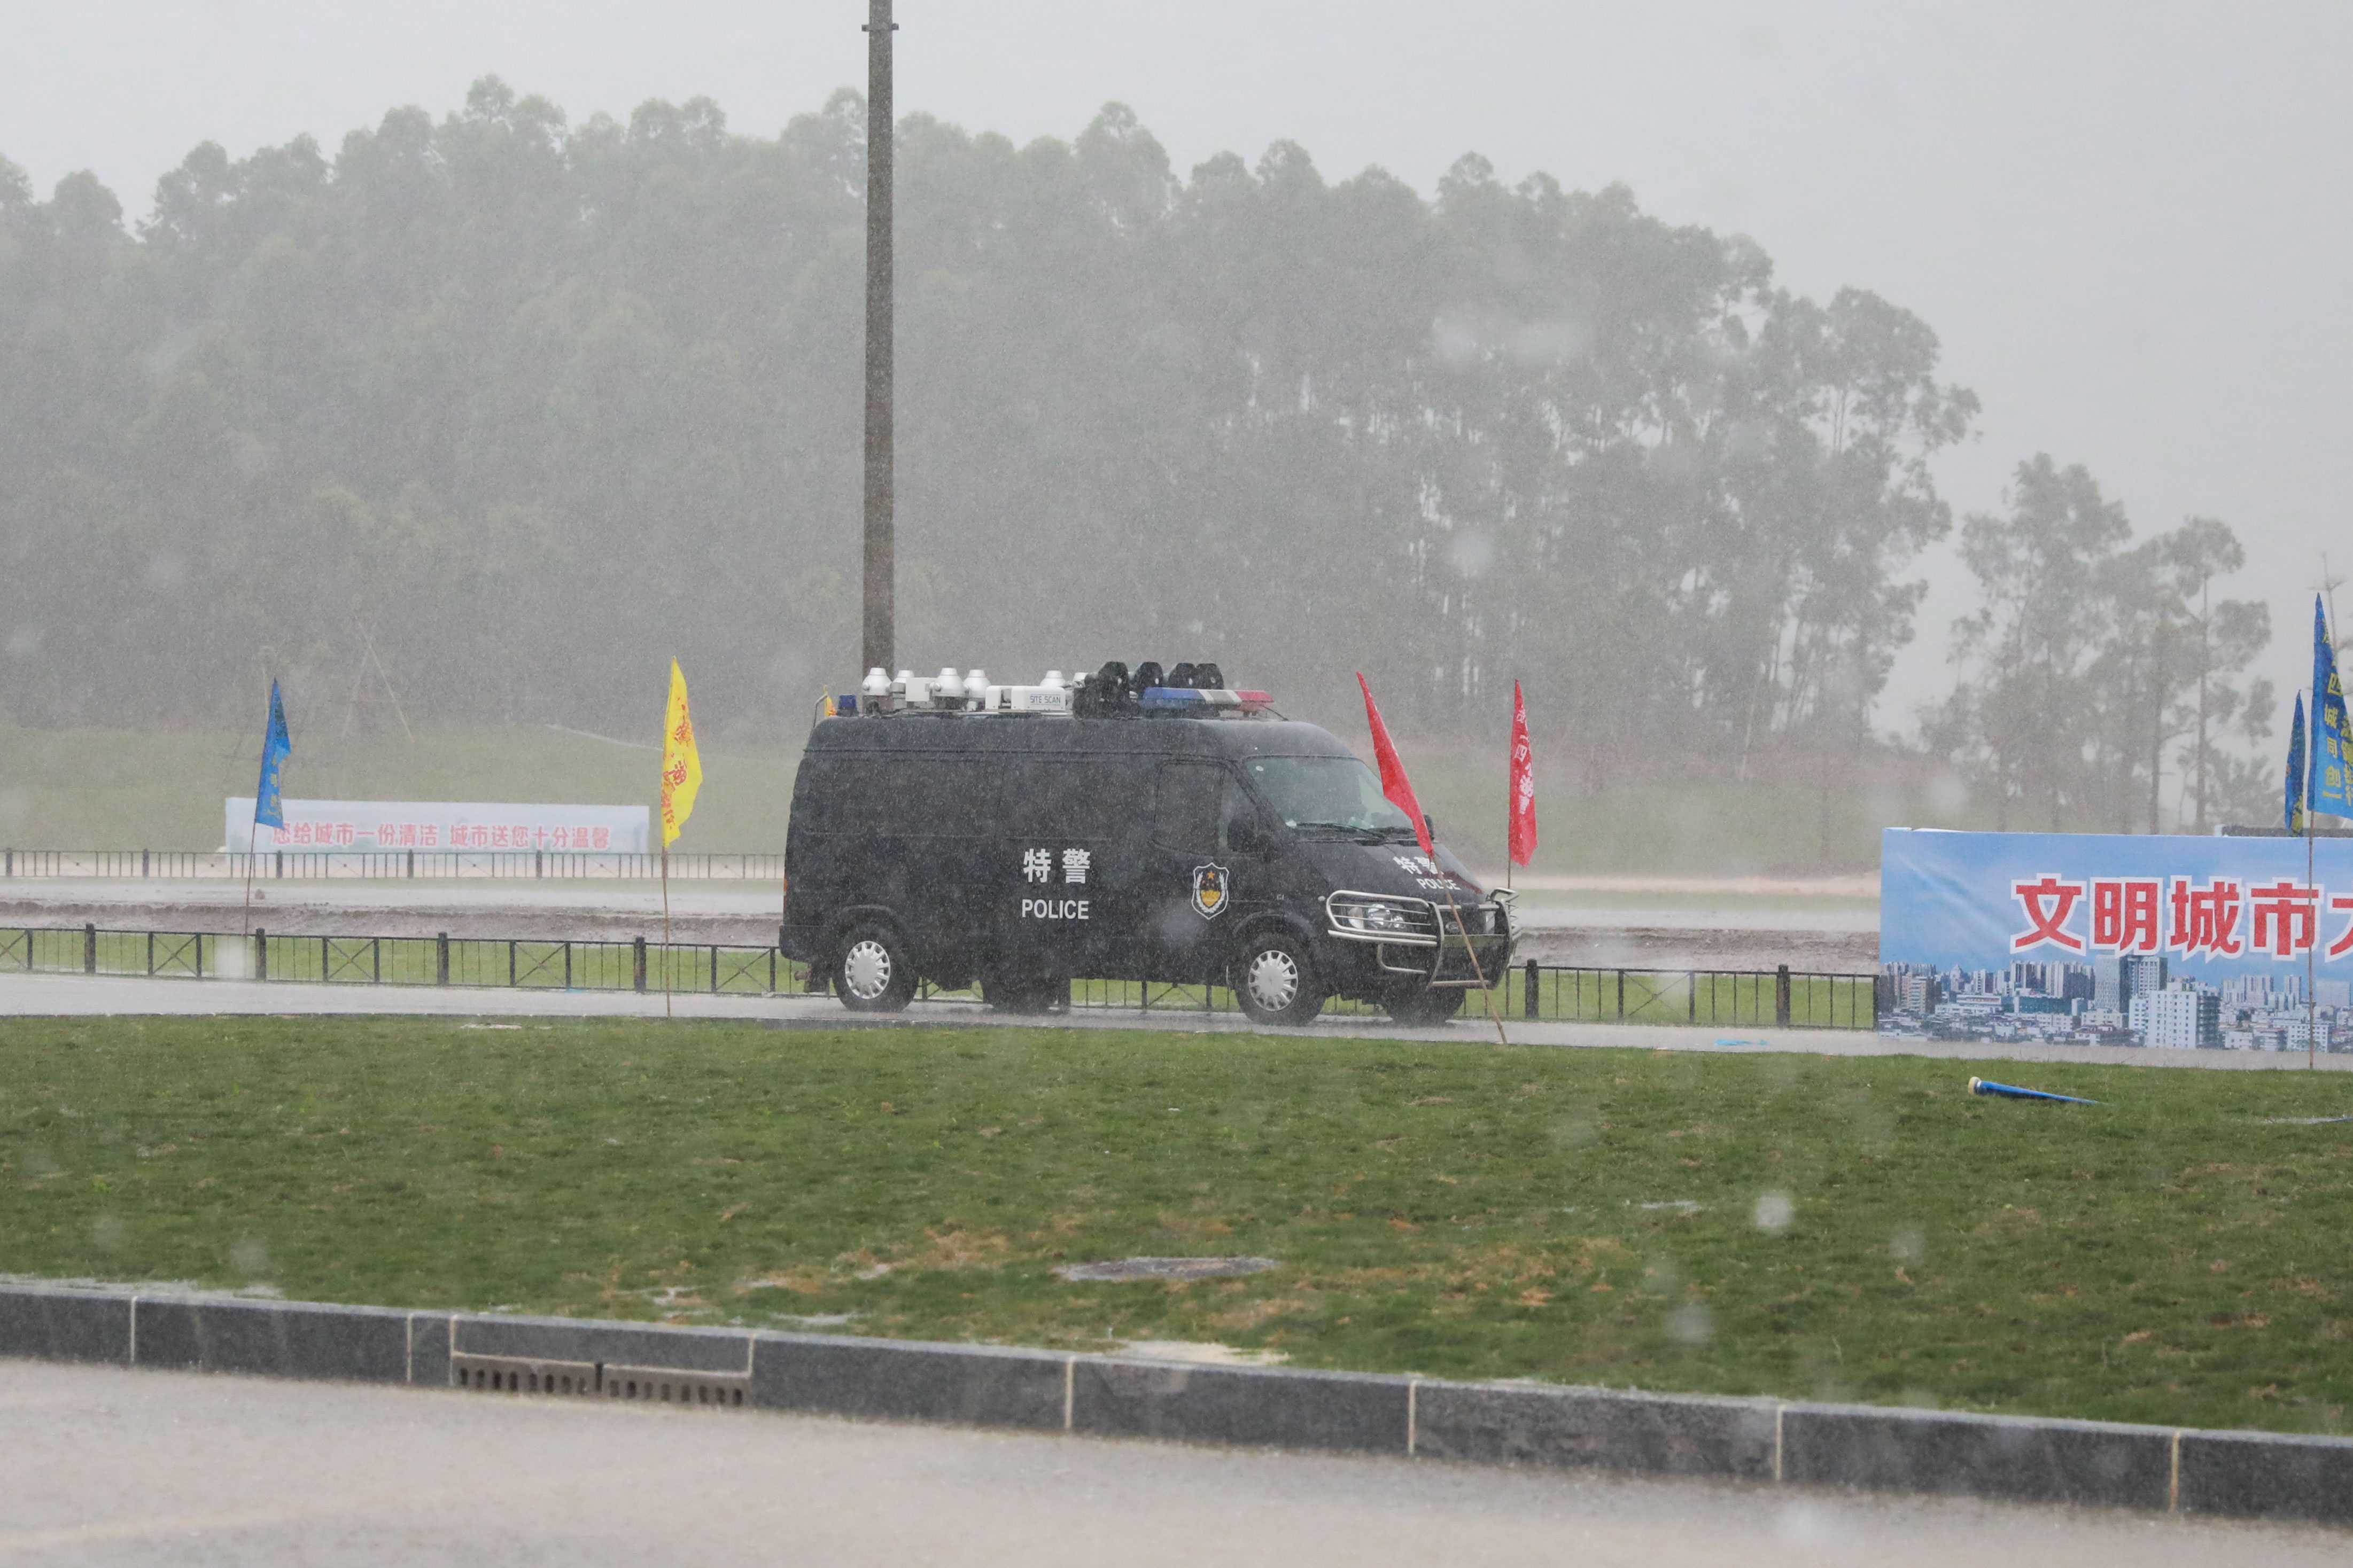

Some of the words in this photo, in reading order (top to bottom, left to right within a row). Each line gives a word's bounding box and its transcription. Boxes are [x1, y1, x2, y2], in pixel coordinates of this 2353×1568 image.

[1030, 696, 1042, 704] SITE
[1044, 696, 1061, 704] SCAN
[1023, 848, 1091, 884] 特警
[1393, 856, 1445, 875] 特警
[1022, 899, 1090, 919] POLICE
